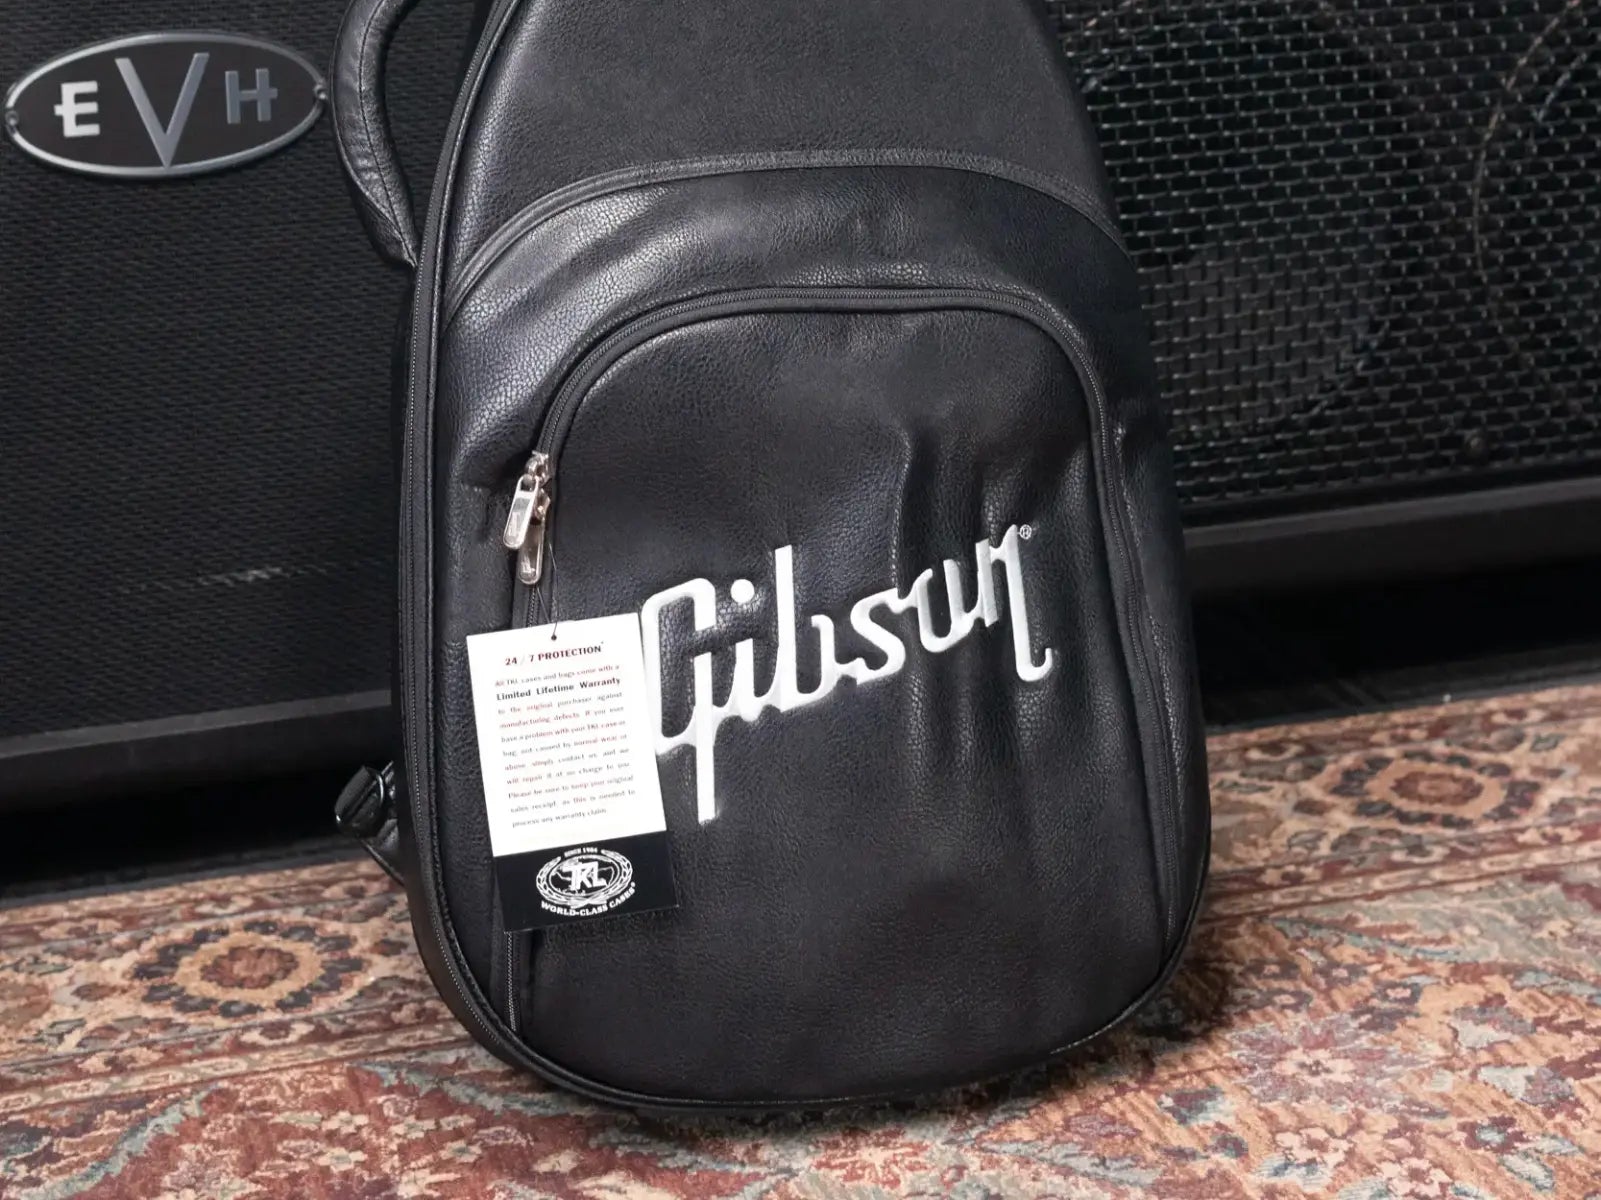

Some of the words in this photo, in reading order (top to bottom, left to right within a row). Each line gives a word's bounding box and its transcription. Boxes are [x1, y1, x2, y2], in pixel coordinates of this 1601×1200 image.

[53, 51, 279, 170] EVH
[505, 656, 518, 666] 24
[529, 654, 536, 663] 7
[538, 645, 602, 662] PROTECTION
[520, 675, 542, 683] cases
[542, 672, 558, 680] and
[557, 670, 576, 678] bags
[597, 664, 614, 672] with
[640, 523, 1054, 826] Gibson
[496, 689, 531, 701] Limited
[536, 684, 574, 695] Lifetime
[579, 676, 620, 689] Warranty
[526, 702, 554, 710] original
[556, 697, 593, 708] purchaser
[597, 692, 623, 701] against
[500, 717, 551, 728] manufacturing
[523, 731, 554, 740] problem
[553, 727, 570, 735] with
[570, 725, 586, 733] your
[602, 748, 617, 756] and
[505, 777, 520, 785] will
[561, 860, 608, 892] TKL
[540, 899, 609, 917] WORLD-CLASS
[608, 886, 636, 909] CASES
